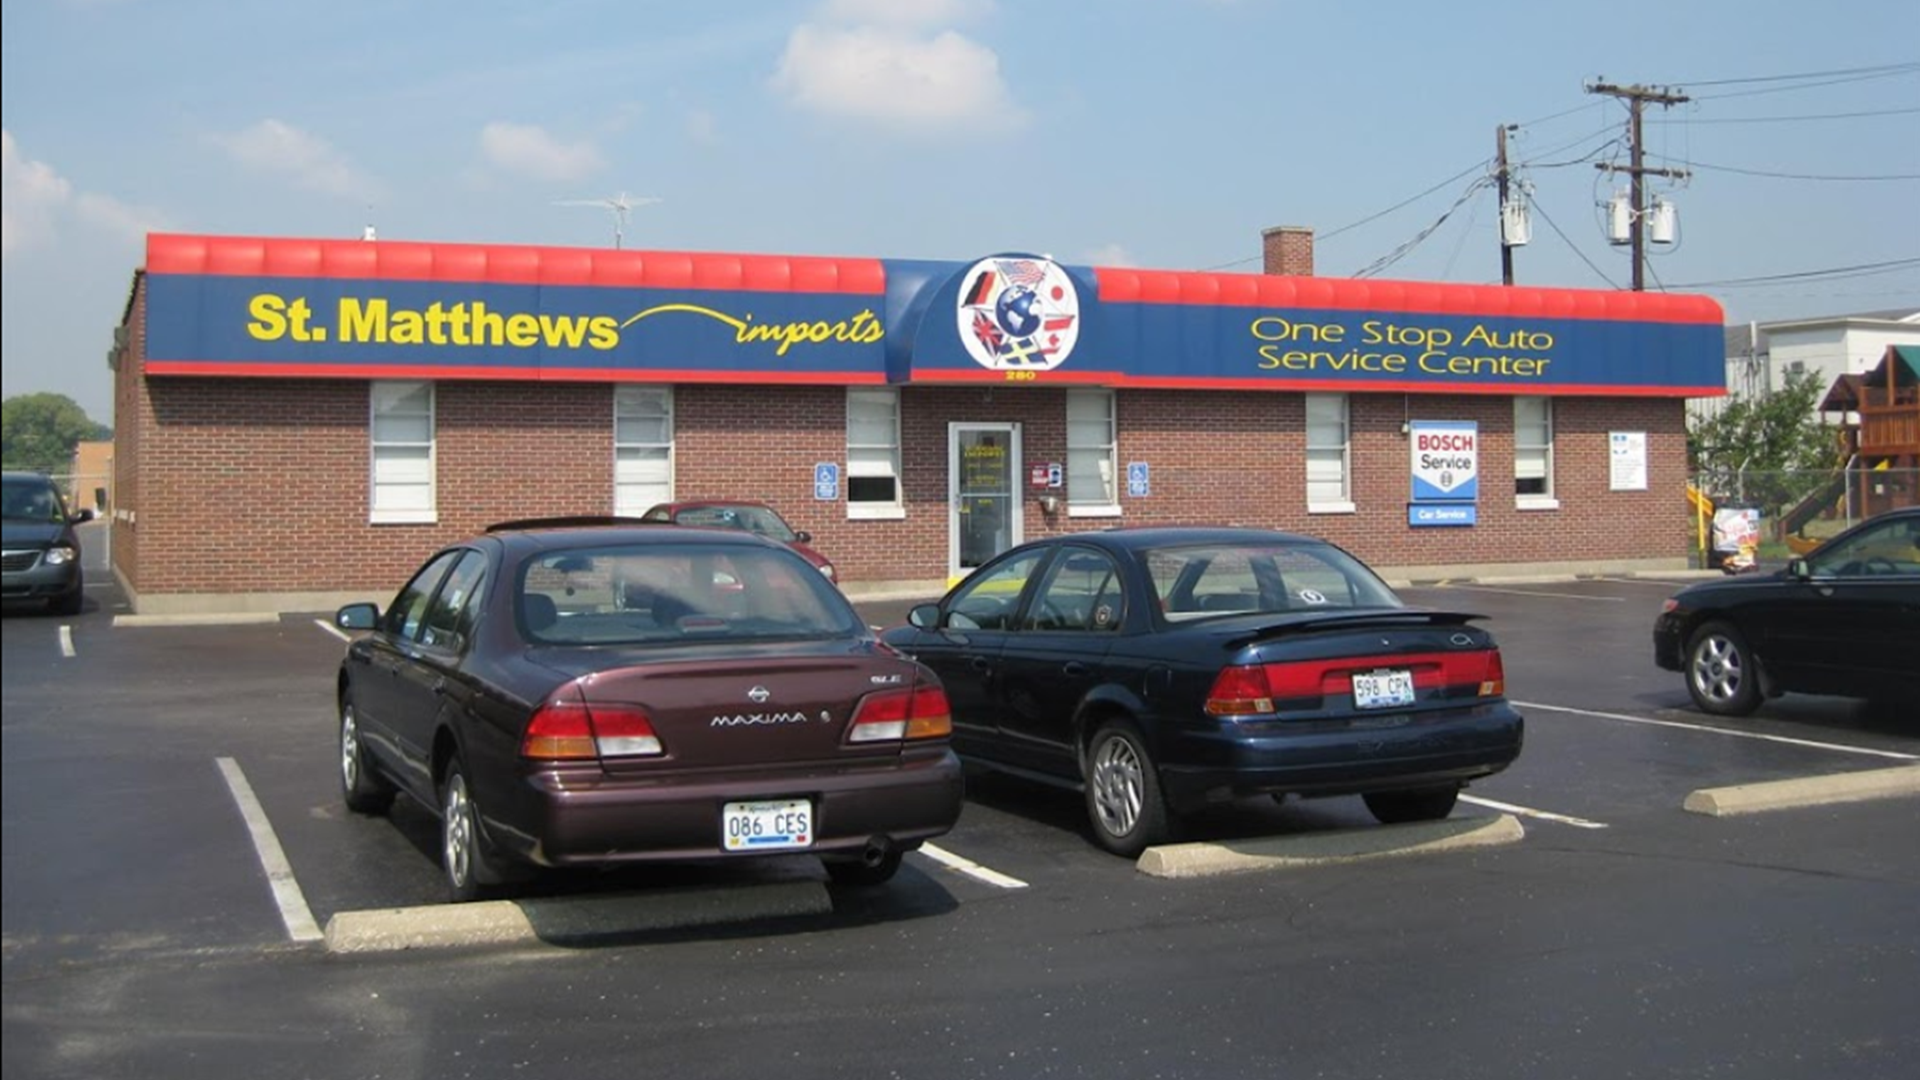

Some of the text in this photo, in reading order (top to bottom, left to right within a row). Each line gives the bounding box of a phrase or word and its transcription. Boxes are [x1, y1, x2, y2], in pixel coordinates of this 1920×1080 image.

[247, 293, 885, 356] St. Matthews imports
[1250, 316, 1554, 351] One Stop Auto
[1257, 345, 1552, 377] Service Center
[1004, 370, 1037, 381] 280
[1418, 434, 1474, 451] BOSCH
[1420, 453, 1472, 470] Service
[1356, 679, 1380, 698] 598
[710, 711, 807, 726] MAXIMA
[729, 812, 808, 837] 086 CES
